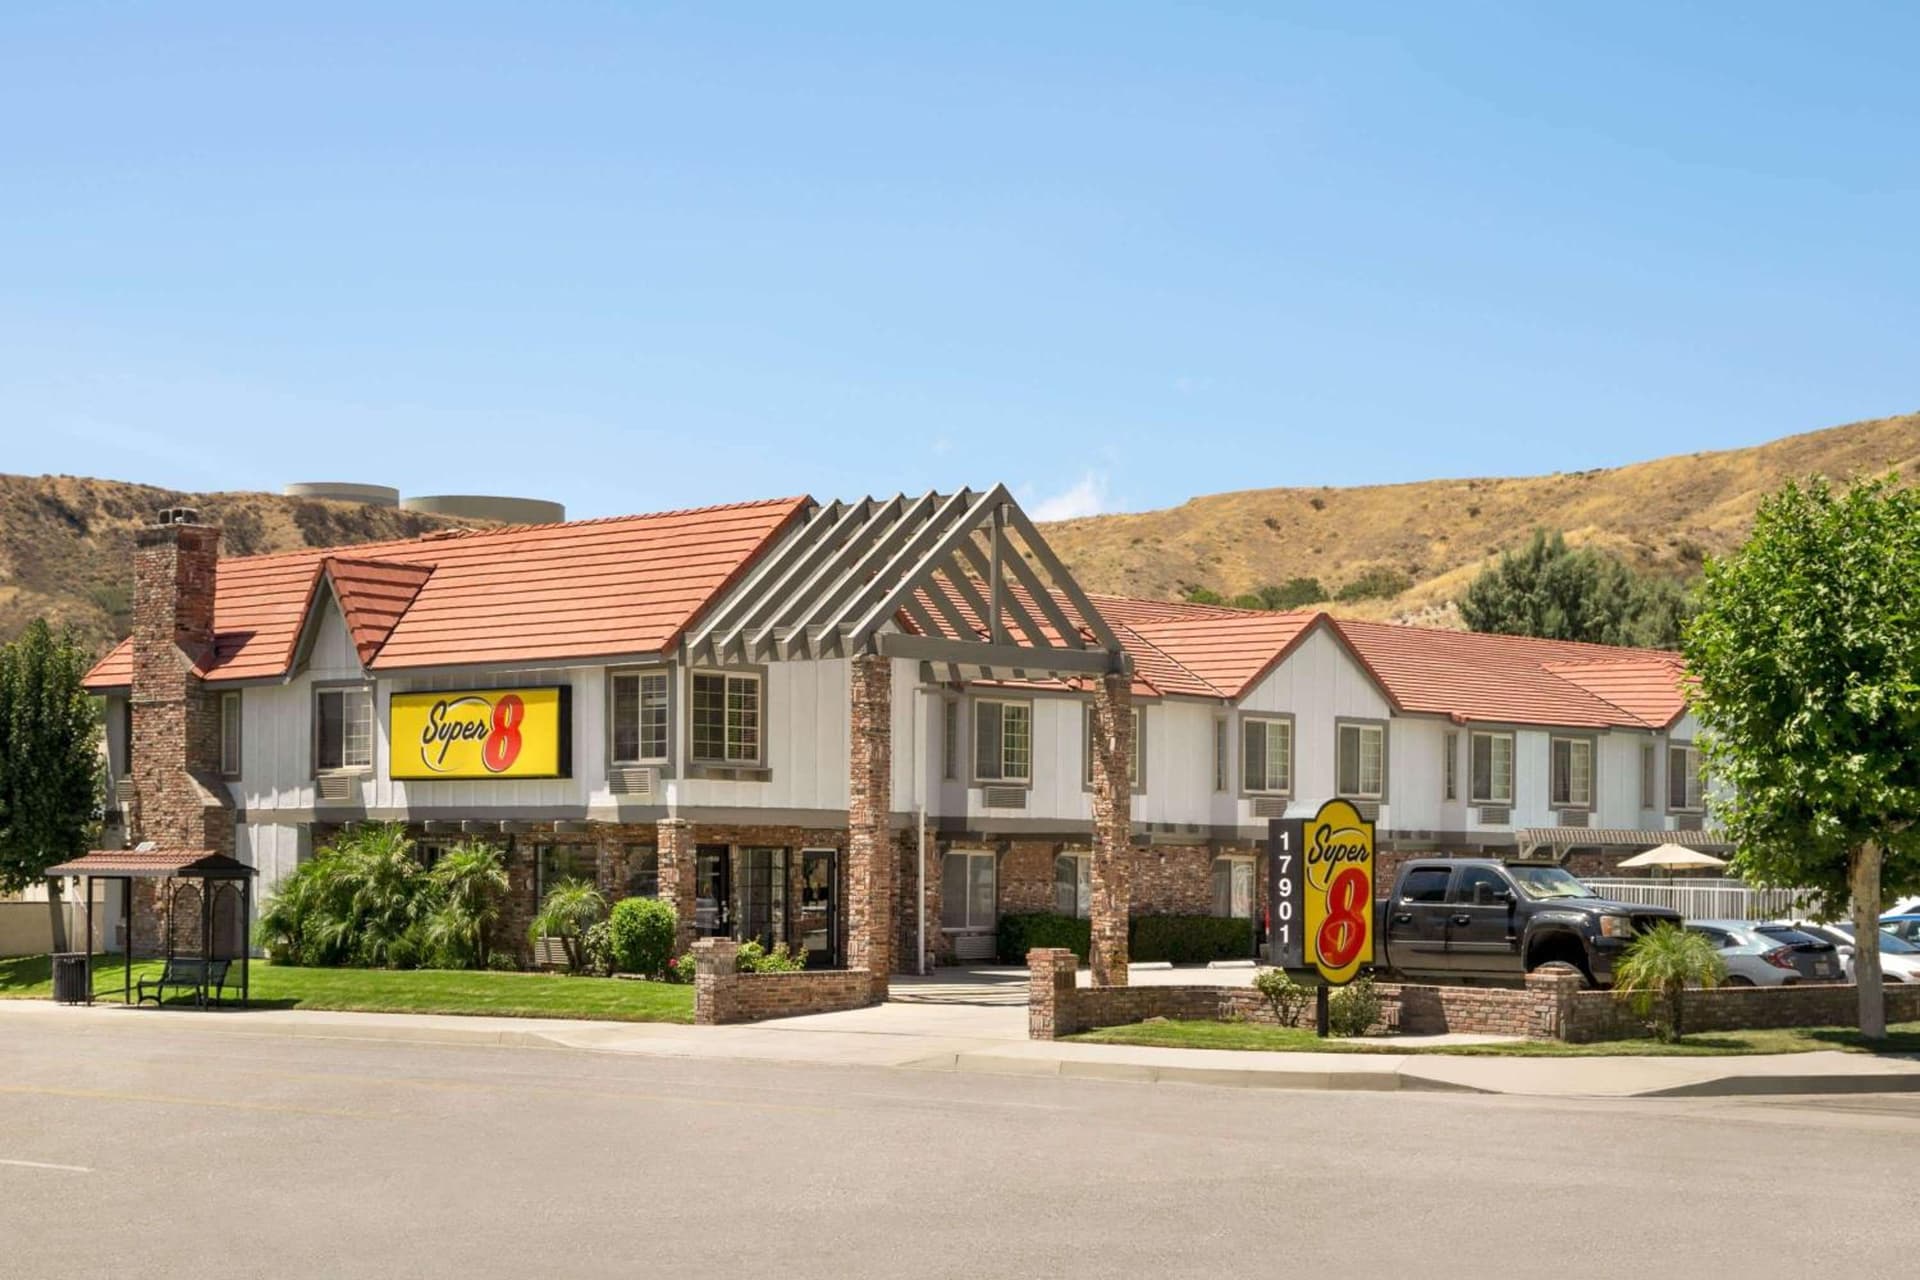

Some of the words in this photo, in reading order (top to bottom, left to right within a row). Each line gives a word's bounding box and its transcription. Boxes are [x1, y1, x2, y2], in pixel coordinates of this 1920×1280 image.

[422, 700, 489, 765] Super
[482, 694, 525, 773] 8
[1278, 831, 1292, 944] 17901
[1307, 823, 1370, 884] Super
[1316, 867, 1370, 969] 8
